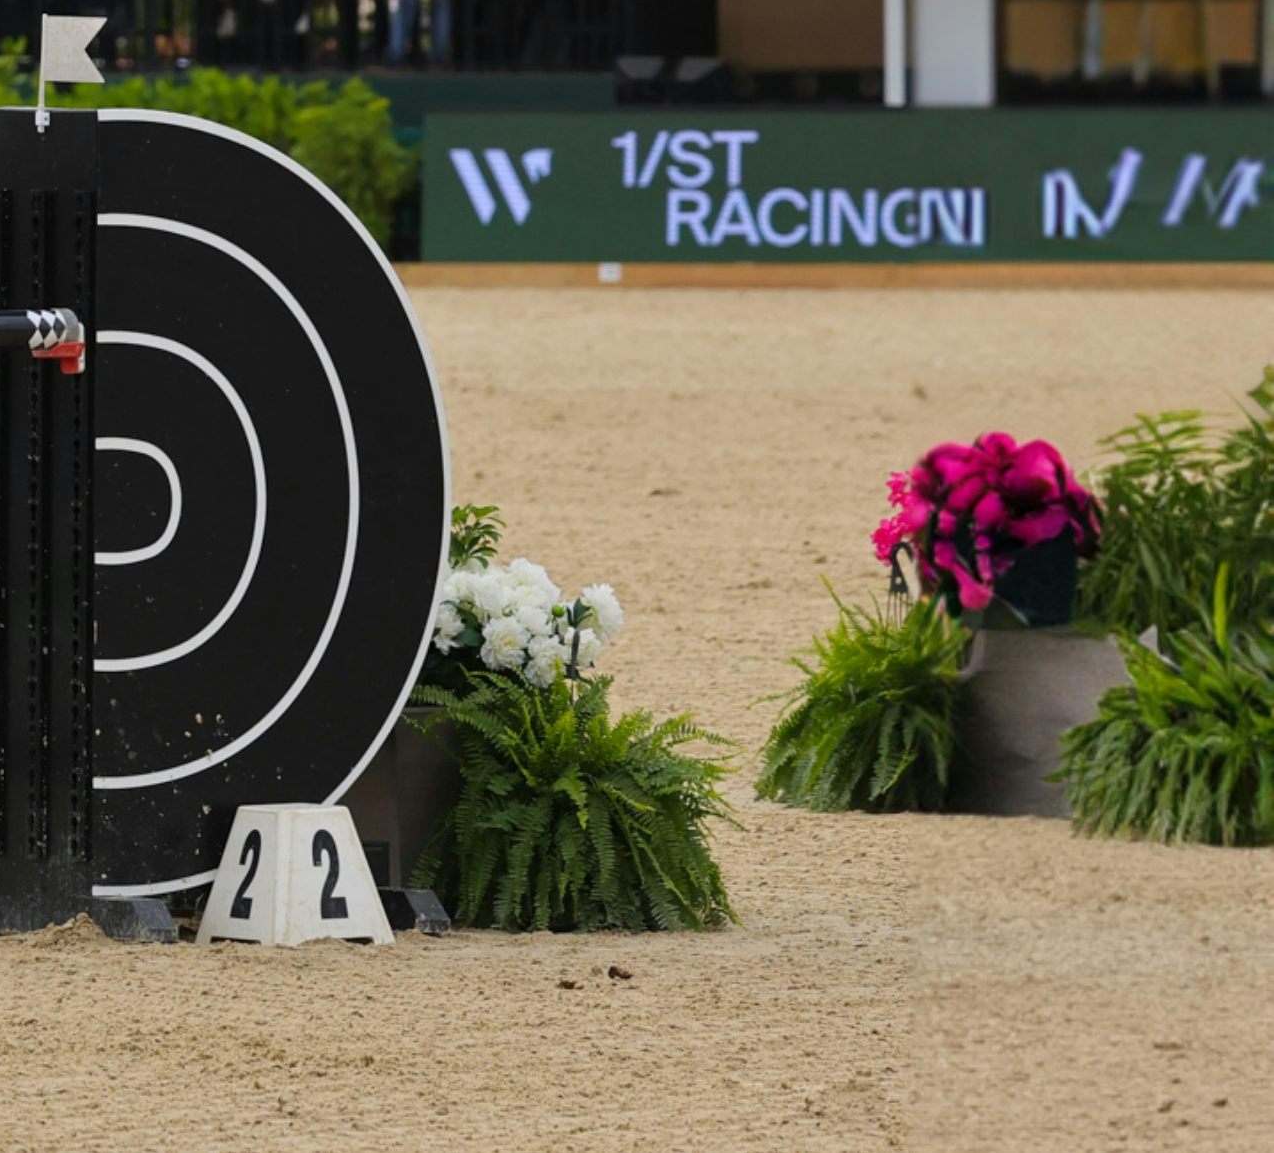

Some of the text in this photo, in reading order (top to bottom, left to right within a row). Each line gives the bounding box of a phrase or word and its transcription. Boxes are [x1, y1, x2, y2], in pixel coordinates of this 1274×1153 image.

[610, 129, 760, 189] 1/ST
[229, 828, 263, 920] 2
[311, 828, 350, 920] 2
